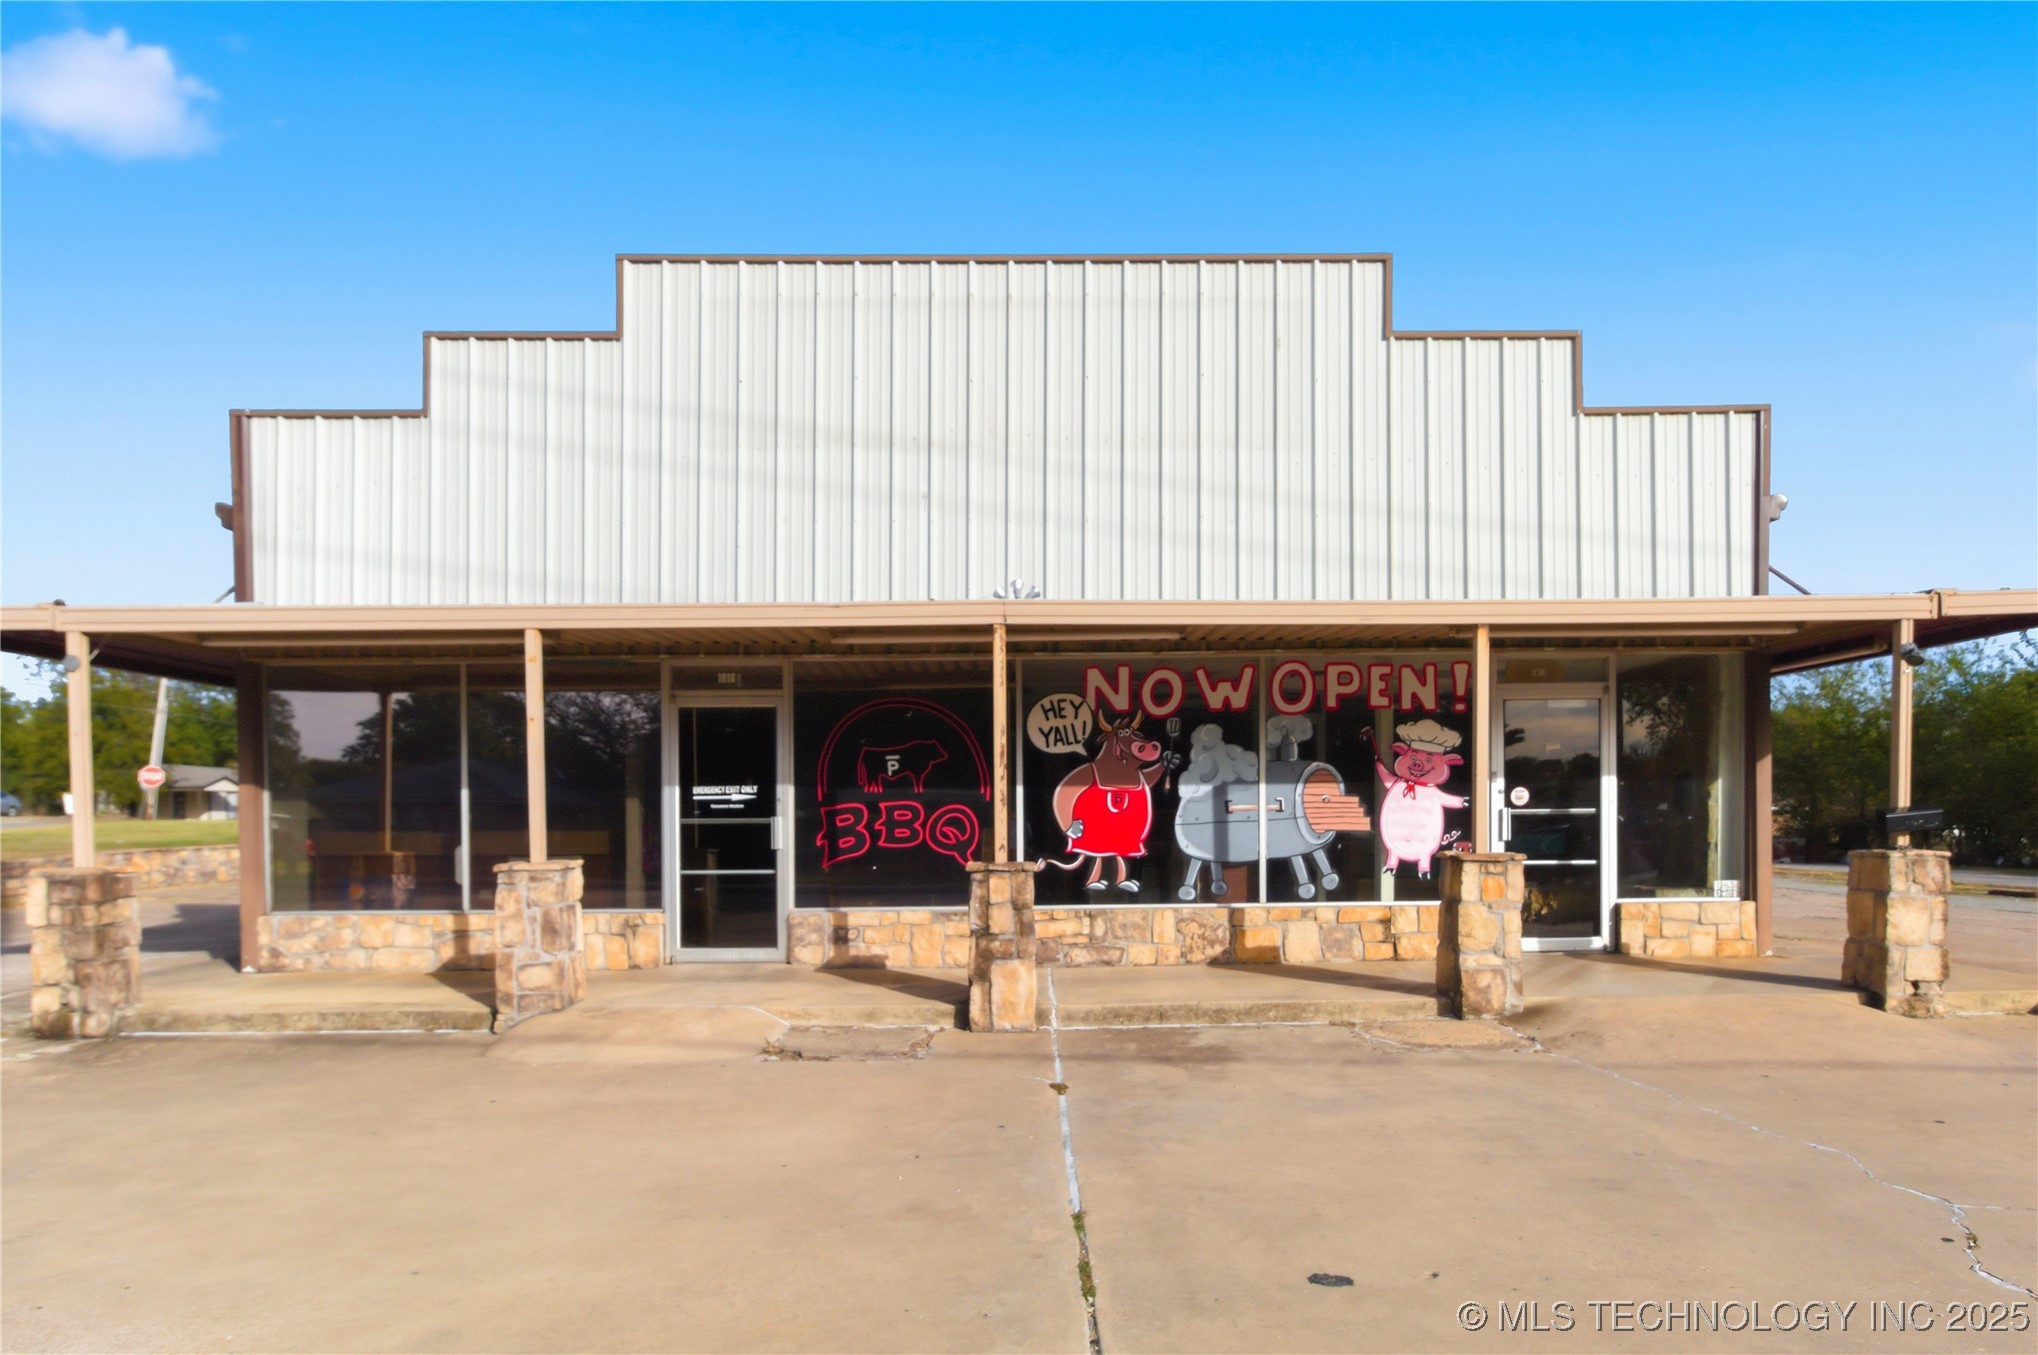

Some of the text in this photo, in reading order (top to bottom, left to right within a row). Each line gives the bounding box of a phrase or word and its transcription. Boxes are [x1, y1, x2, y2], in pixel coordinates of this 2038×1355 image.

[1084, 660, 1473, 719] NOW OPEN!
[1040, 698, 1085, 721] HEY
[1038, 720, 1087, 748] YALL!
[692, 784, 758, 795] EMERGENCY EXIT ONLY
[816, 801, 980, 869] BBQ
